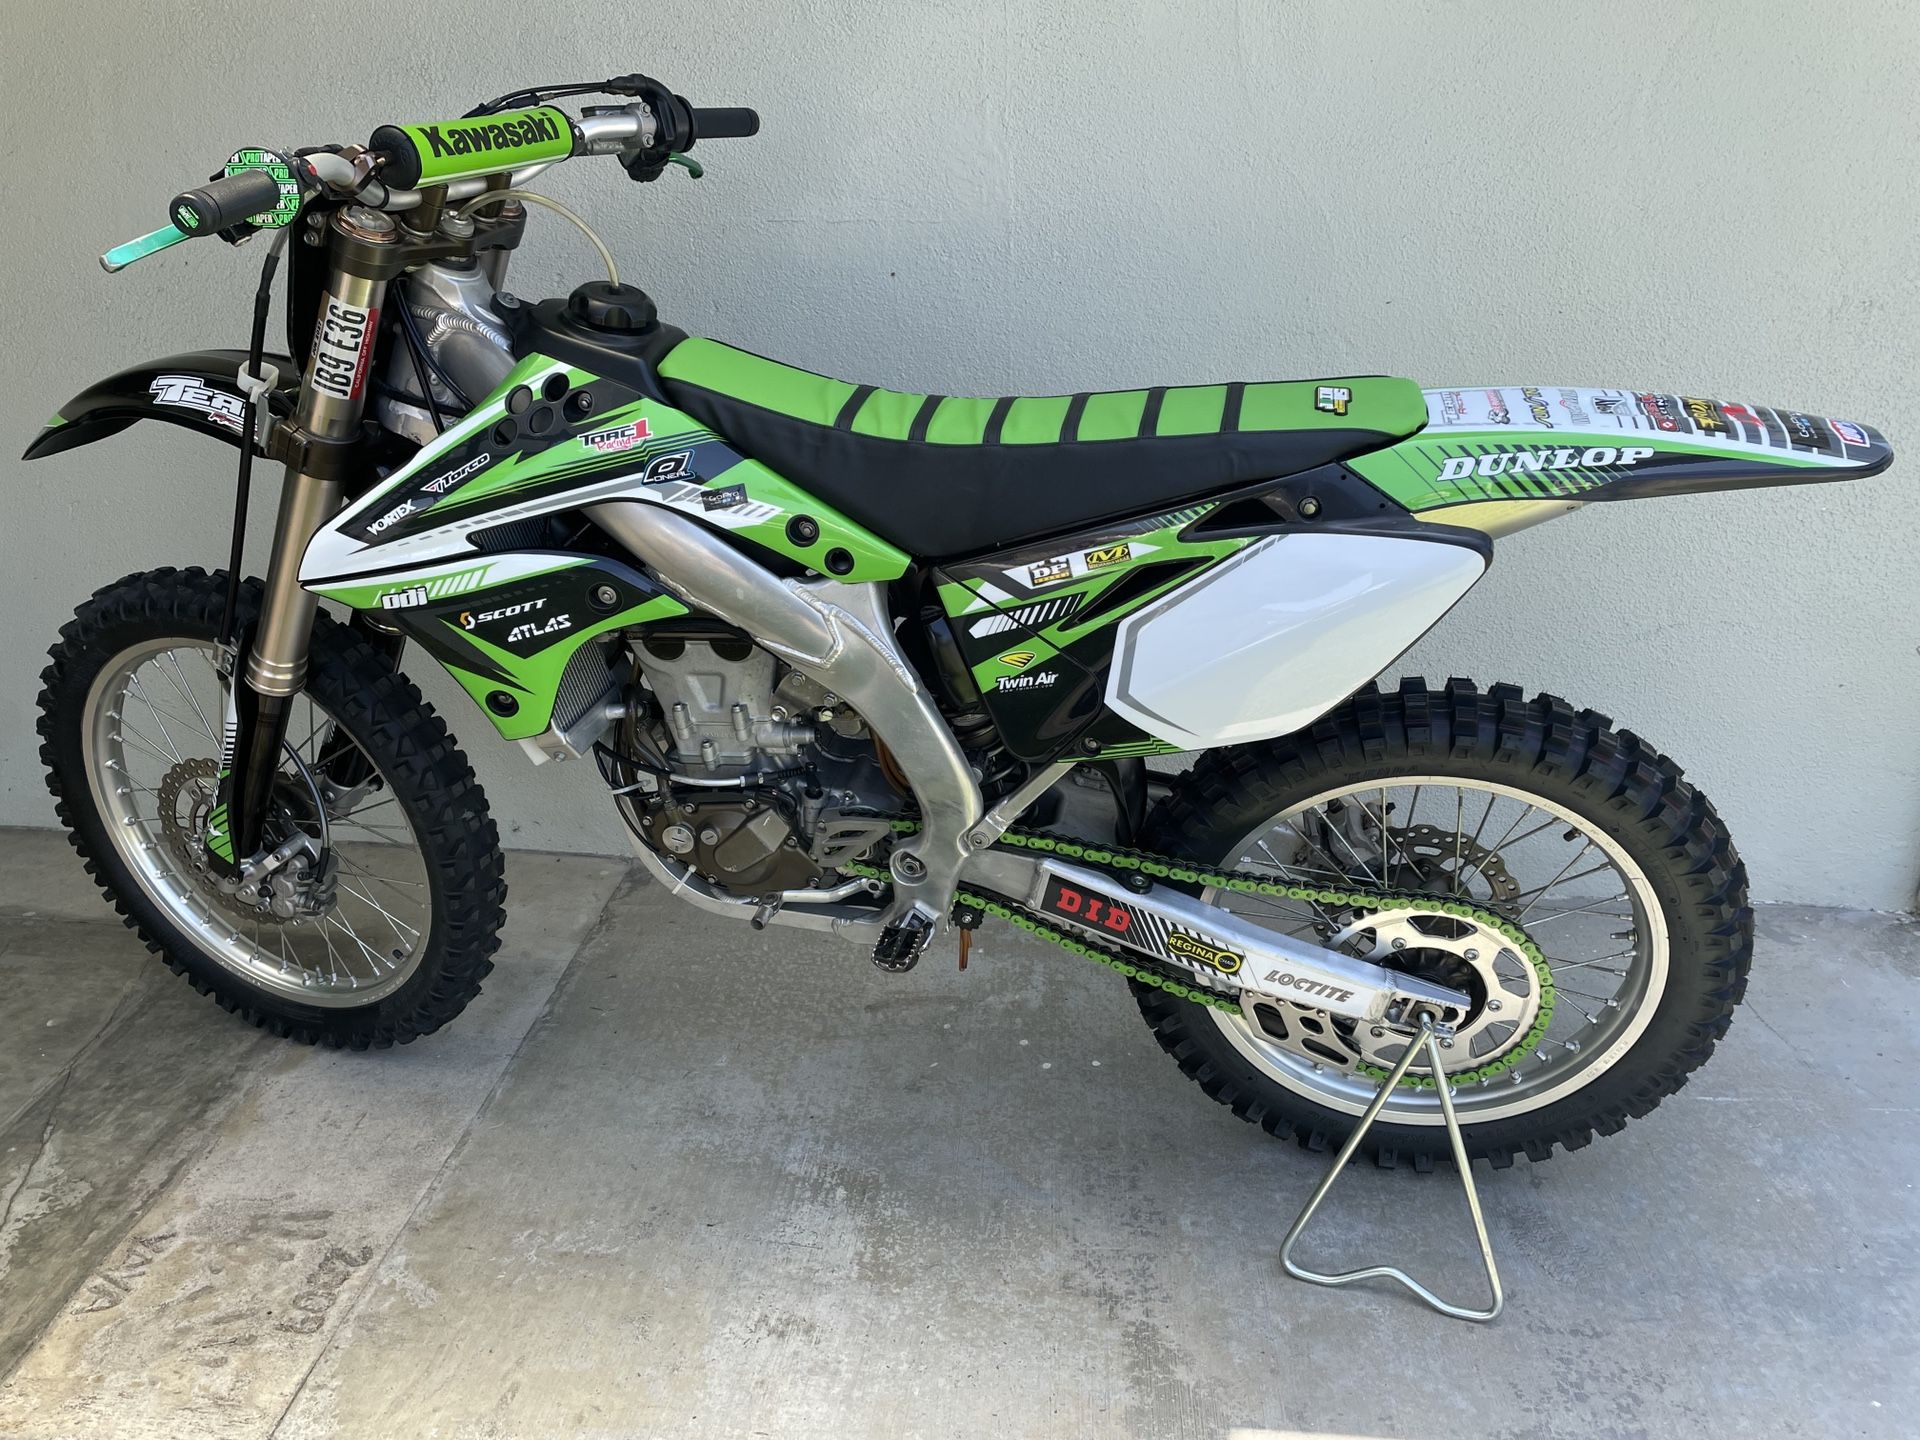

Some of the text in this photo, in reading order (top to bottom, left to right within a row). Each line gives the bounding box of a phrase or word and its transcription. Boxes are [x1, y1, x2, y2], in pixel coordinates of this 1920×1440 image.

[416, 112, 560, 158] Kawasaki
[313, 304, 367, 397] JB9 E36
[355, 358, 366, 388] CALIFORNIA
[149, 375, 246, 420] TEA
[578, 418, 652, 447] TORC1
[595, 437, 633, 452] Racing
[438, 453, 490, 491] Torco
[1436, 447, 1654, 482] DUNLOP
[366, 499, 416, 535] VORTEX
[382, 586, 428, 610] odi
[476, 598, 547, 624] SCOTT
[508, 614, 572, 642] ATLAS
[997, 674, 1034, 690] Twin
[1035, 671, 1059, 686] Air
[1170, 937, 1236, 967] REGINA CHAIN
[1264, 969, 1355, 1002] LOCTITE
